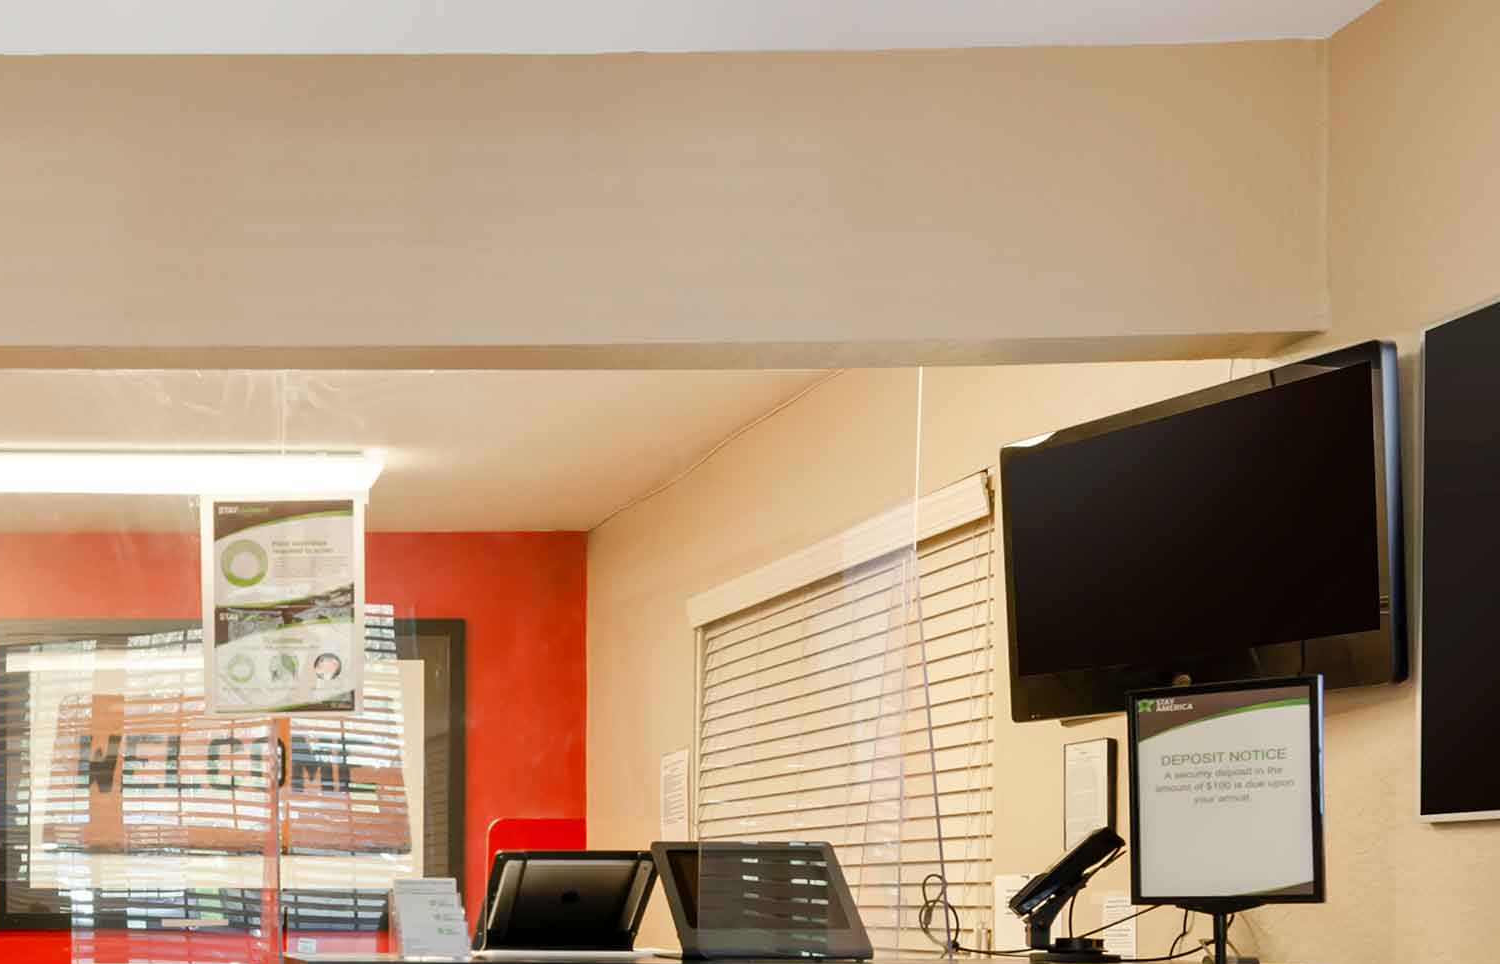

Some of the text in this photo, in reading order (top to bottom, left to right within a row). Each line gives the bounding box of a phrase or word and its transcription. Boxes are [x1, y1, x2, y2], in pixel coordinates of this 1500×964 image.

[1156, 703, 1193, 711] AMERICA
[1161, 748, 1287, 766] DEPOSIT NOTICE
[1164, 772, 1172, 780] A
[1215, 767, 1253, 778] deposit
[1254, 767, 1265, 776] in
[1267, 766, 1283, 775] the
[1156, 783, 1192, 792] amount
[1194, 782, 1204, 791] of
[1206, 780, 1232, 791] $100
[1245, 779, 1265, 788] due
[1268, 779, 1296, 788] upon
